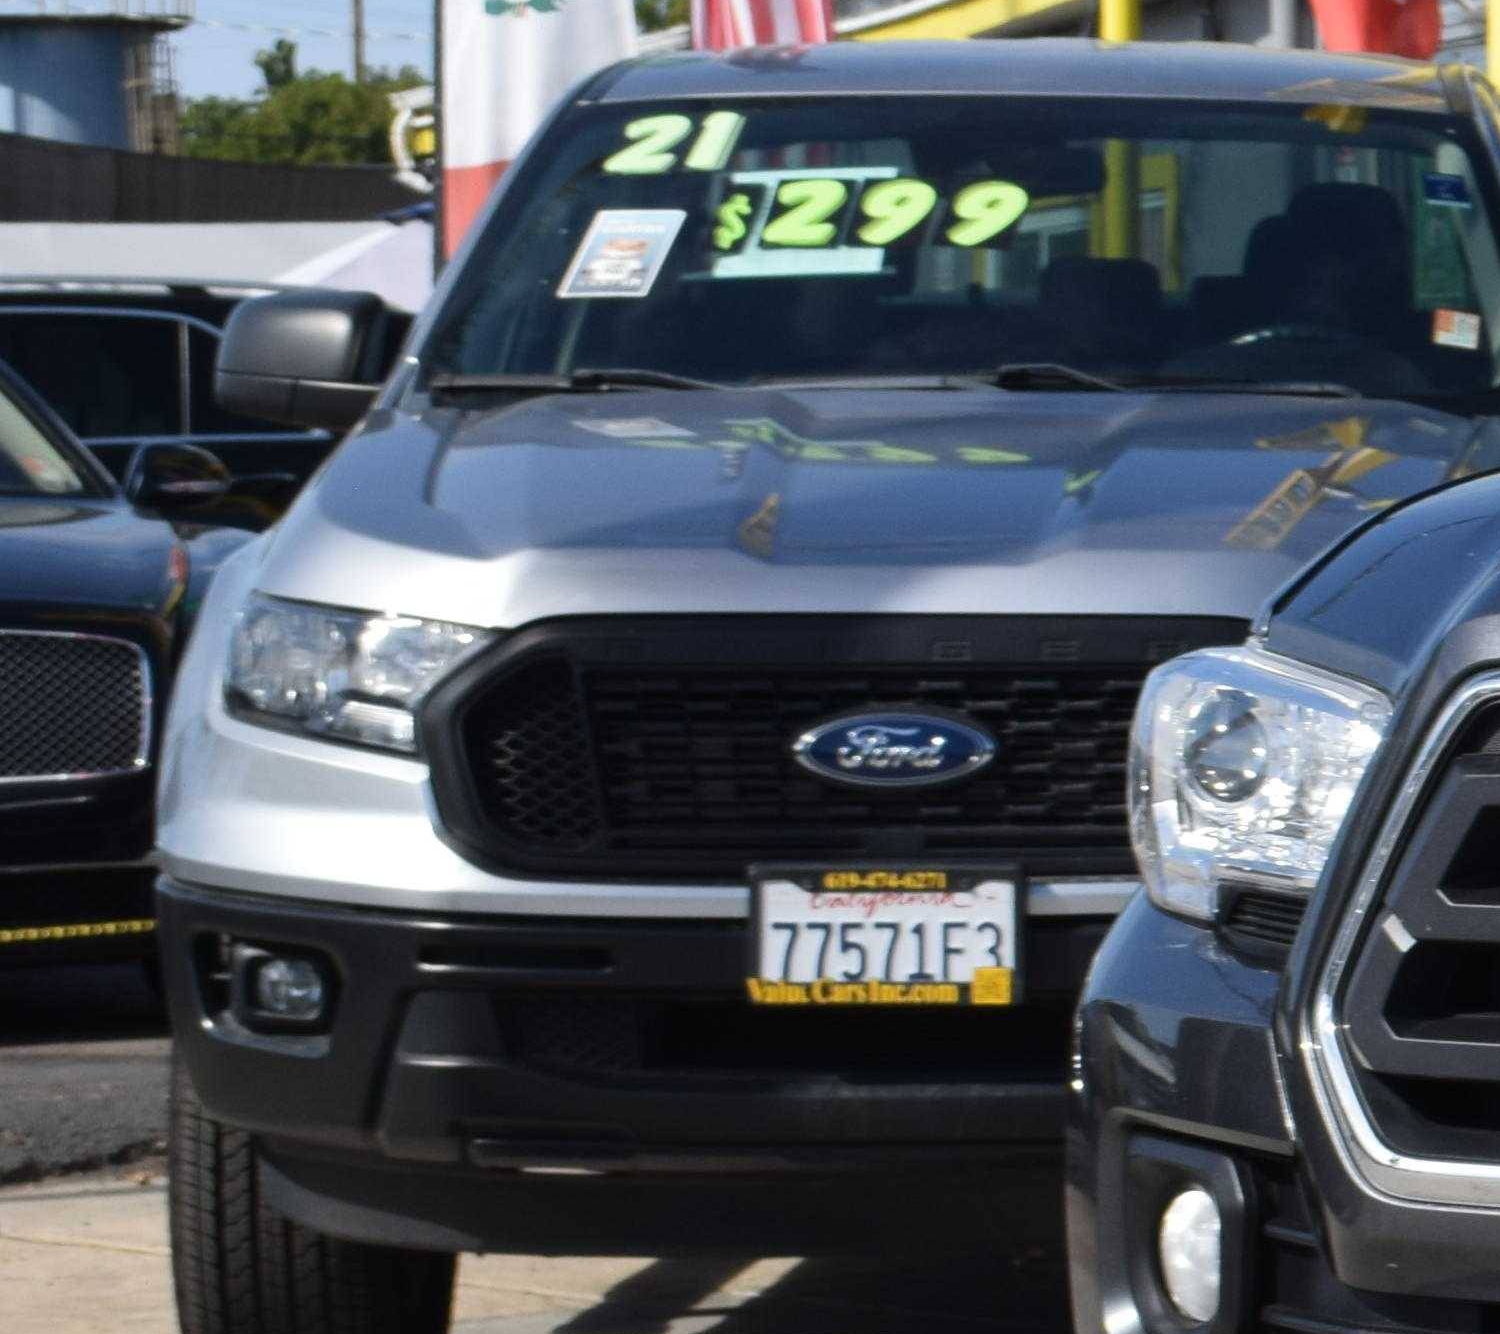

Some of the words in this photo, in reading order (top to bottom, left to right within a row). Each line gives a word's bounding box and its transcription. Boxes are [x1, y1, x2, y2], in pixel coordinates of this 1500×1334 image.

[603, 110, 748, 175] 21
[713, 176, 1030, 251] $299
[838, 724, 946, 768] Ford
[822, 870, 947, 890] 619-474-6271
[770, 921, 1004, 983] 77571F3
